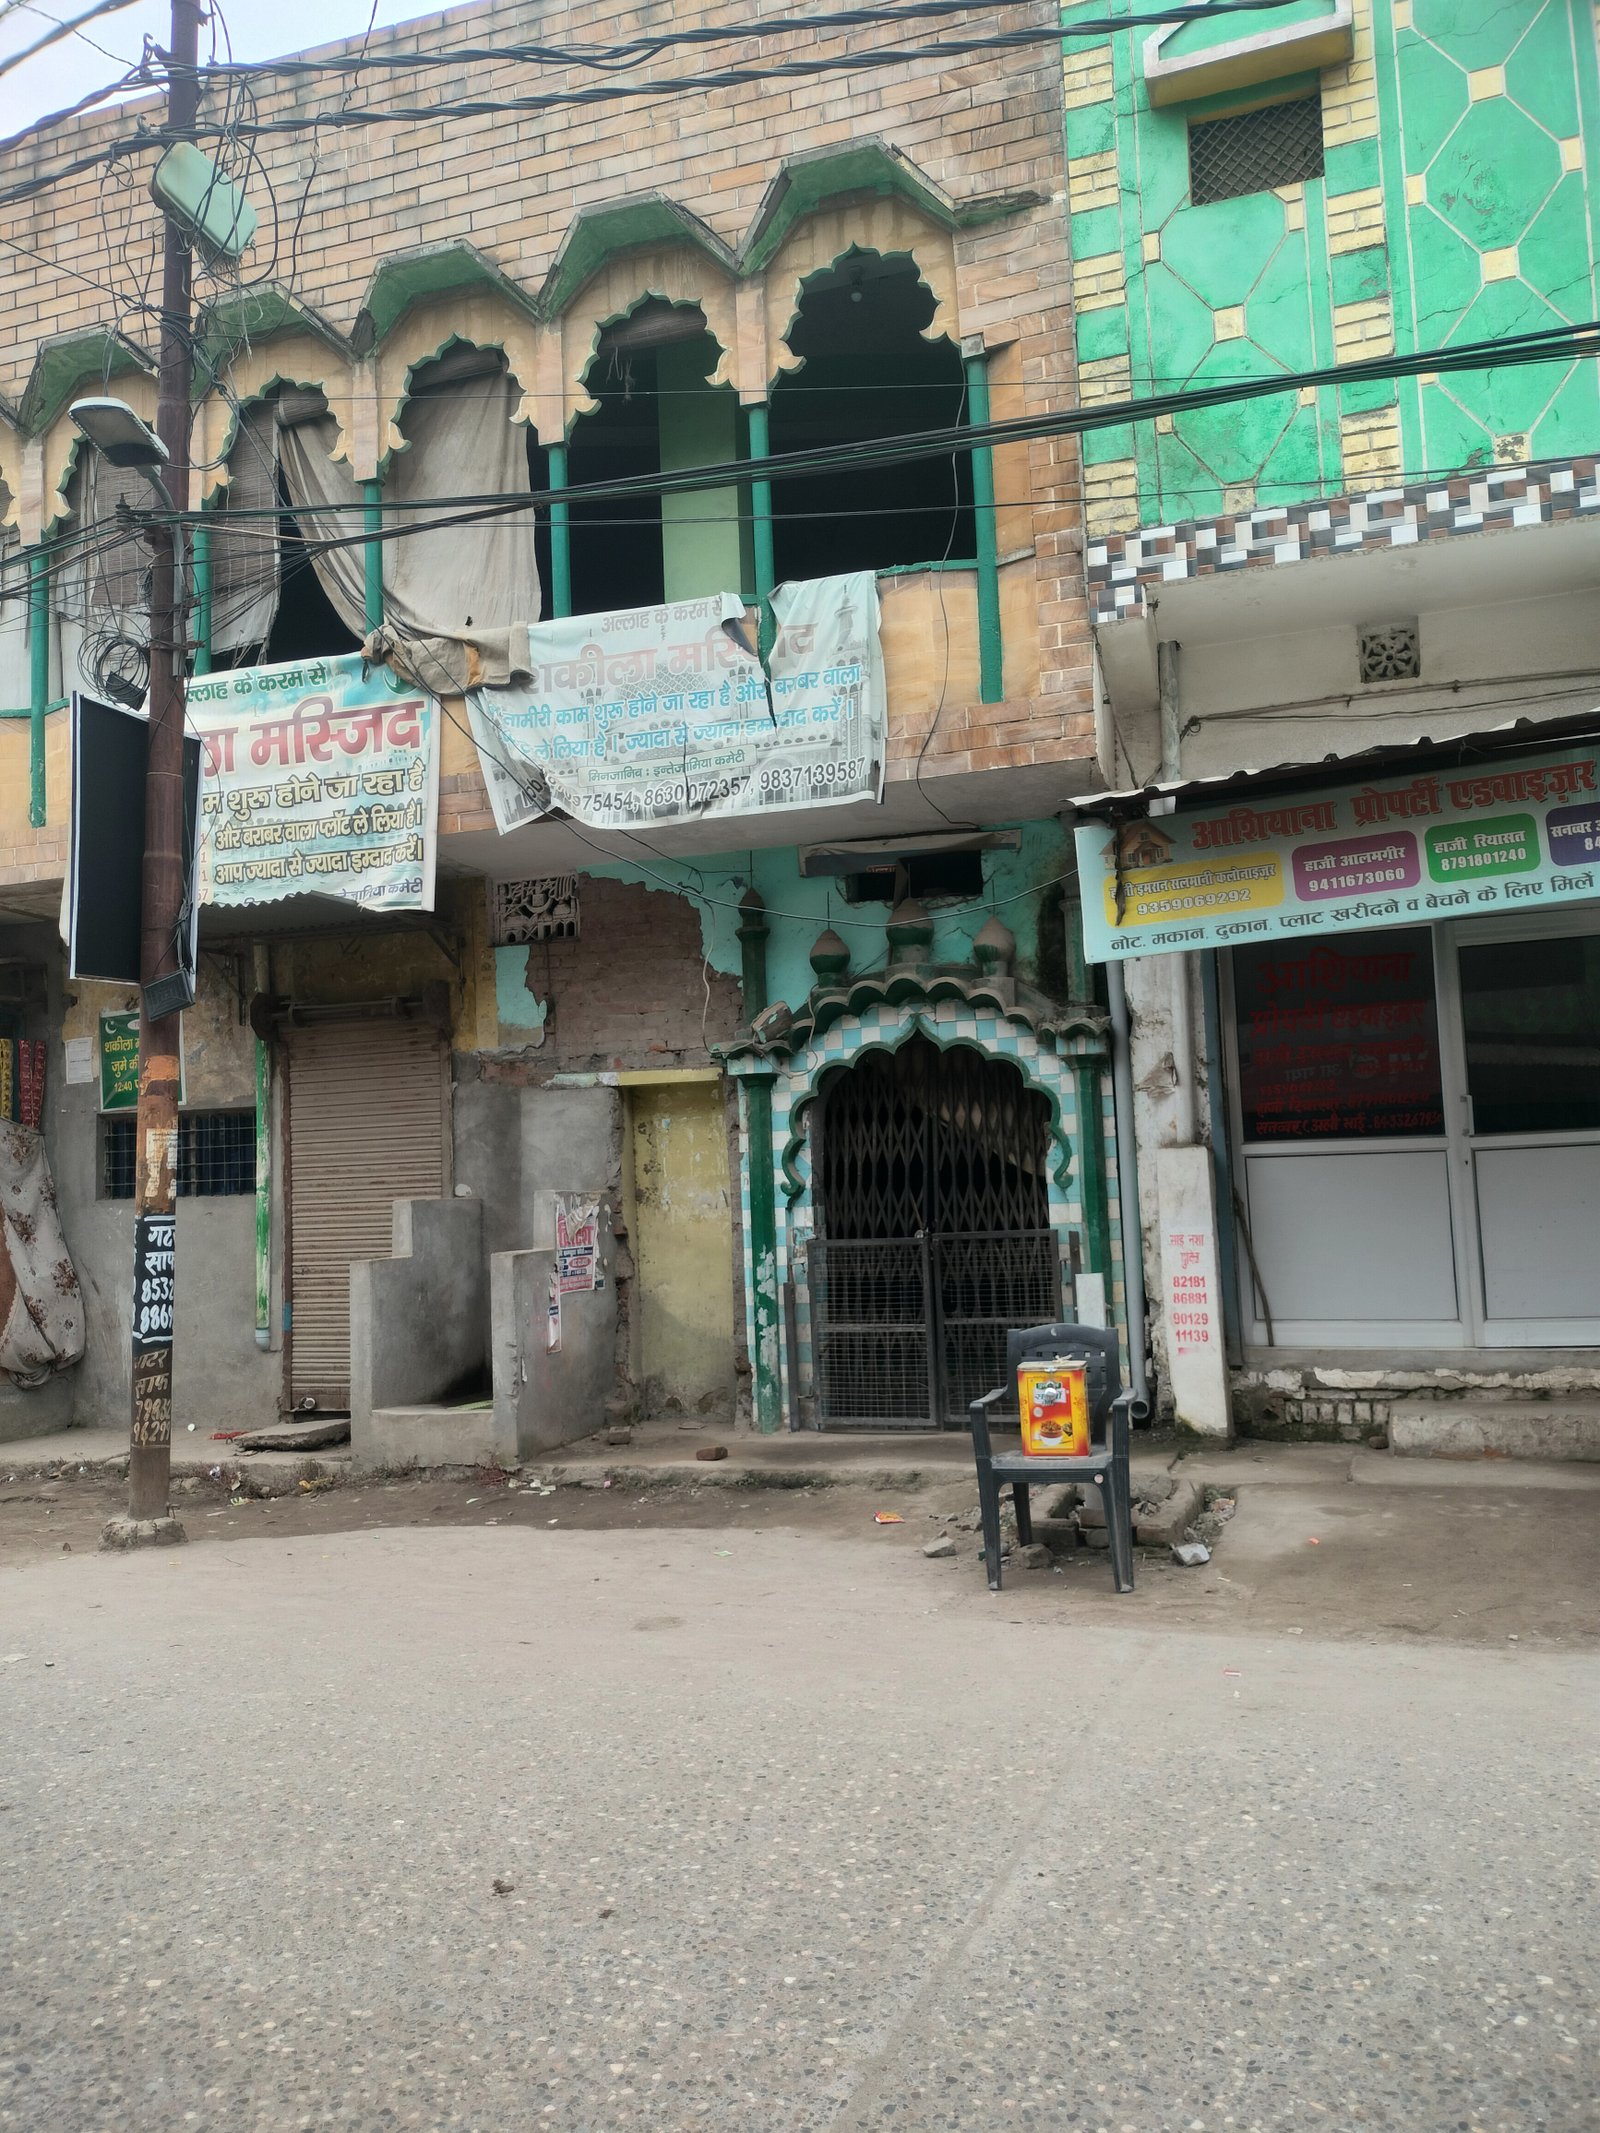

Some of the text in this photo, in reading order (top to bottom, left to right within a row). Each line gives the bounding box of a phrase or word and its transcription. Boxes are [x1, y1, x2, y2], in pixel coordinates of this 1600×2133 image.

[602, 611, 649, 633] अल्लाह
[654, 602, 669, 625] के
[673, 602, 709, 622] करम
[233, 672, 253, 695] के
[257, 669, 303, 692] करम
[308, 661, 326, 685] से
[556, 706, 589, 726] काम
[628, 691, 658, 719] होने
[663, 692, 683, 711] जा
[688, 689, 715, 709] रहा
[719, 680, 731, 706] है
[735, 676, 767, 702] और
[823, 665, 861, 685] वाला
[250, 695, 424, 766] मस्जिद
[553, 735, 589, 759] लिया
[594, 730, 607, 757] है
[625, 729, 669, 750] ज्यादा
[674, 721, 689, 744] से
[693, 721, 740, 742] ज्यादा
[812, 697, 842, 721] करें
[714, 749, 746, 765] कमेटी
[275, 772, 322, 808] होने
[324, 775, 359, 799] जा
[363, 769, 405, 796] रहा
[408, 760, 426, 791] है
[1191, 800, 1338, 850] आशियाना
[1350, 775, 1443, 827] प्रोपर्टी
[215, 820, 242, 850] और
[242, 825, 283, 847] बराबर
[283, 820, 318, 843] वाला
[352, 804, 369, 835] ले
[371, 804, 405, 833] लिया
[1433, 830, 1526, 853] हाजी रियासत
[215, 859, 245, 885] आप
[245, 857, 288, 881] ज्यादा
[287, 848, 305, 877] से
[305, 852, 349, 874] ज्यादा
[1303, 855, 1337, 872] हाजी
[1441, 847, 1527, 871] 8791801240
[388, 877, 423, 894] कमेटी
[1170, 870, 1214, 889] सलमानी
[1308, 867, 1406, 892] 9411673060
[1136, 888, 1251, 915] 9359069292
[1279, 912, 1325, 928] प्लाट
[1330, 899, 1401, 922] खरीदने
[1406, 899, 1420, 912] व
[1426, 889, 1471, 909] बेचने
[1477, 885, 1498, 902] के
[1504, 882, 1544, 899] लिए
[1550, 871, 1595, 893] मिलें
[105, 1036, 133, 1052] शकीला
[111, 1056, 127, 1078] जुमे
[114, 1080, 132, 1092] 12:40
[1173, 1276, 1206, 1288] 82181
[1173, 1312, 1209, 1325] 90129
[1175, 1329, 1209, 1343] 11139
